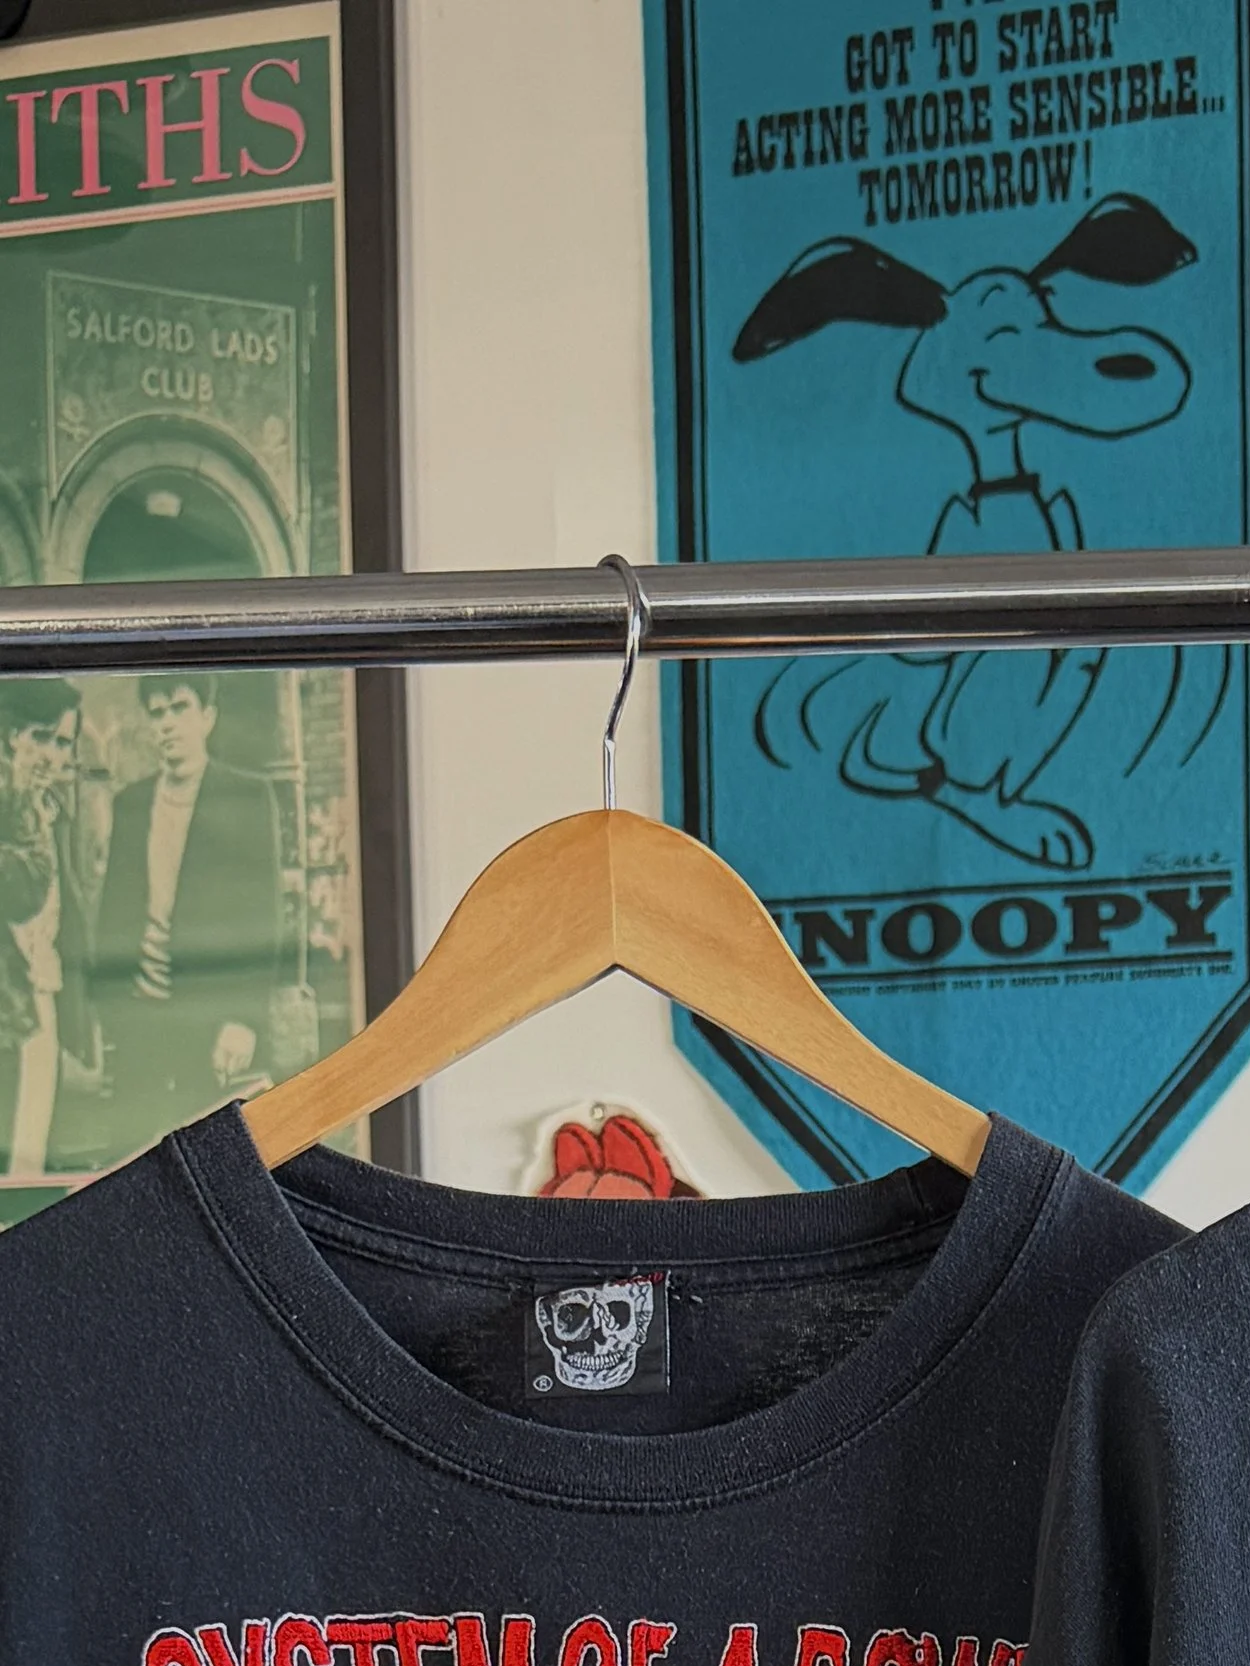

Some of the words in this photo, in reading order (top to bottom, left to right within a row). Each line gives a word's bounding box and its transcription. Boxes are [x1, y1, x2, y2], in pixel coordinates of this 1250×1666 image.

[845, 26, 915, 94] GOT
[932, 18, 980, 81] TO
[997, 1, 1120, 73] START
[6, 58, 306, 205] ITHS
[731, 97, 870, 178] ACTING
[883, 85, 992, 157] MORE
[1008, 55, 1225, 141] SENSIBLE...
[858, 139, 1094, 227] TOMORROW!
[66, 305, 195, 353] SALFORD
[211, 327, 280, 366] LADS
[141, 365, 214, 402] CLUB
[770, 885, 1232, 967] NOOPY
